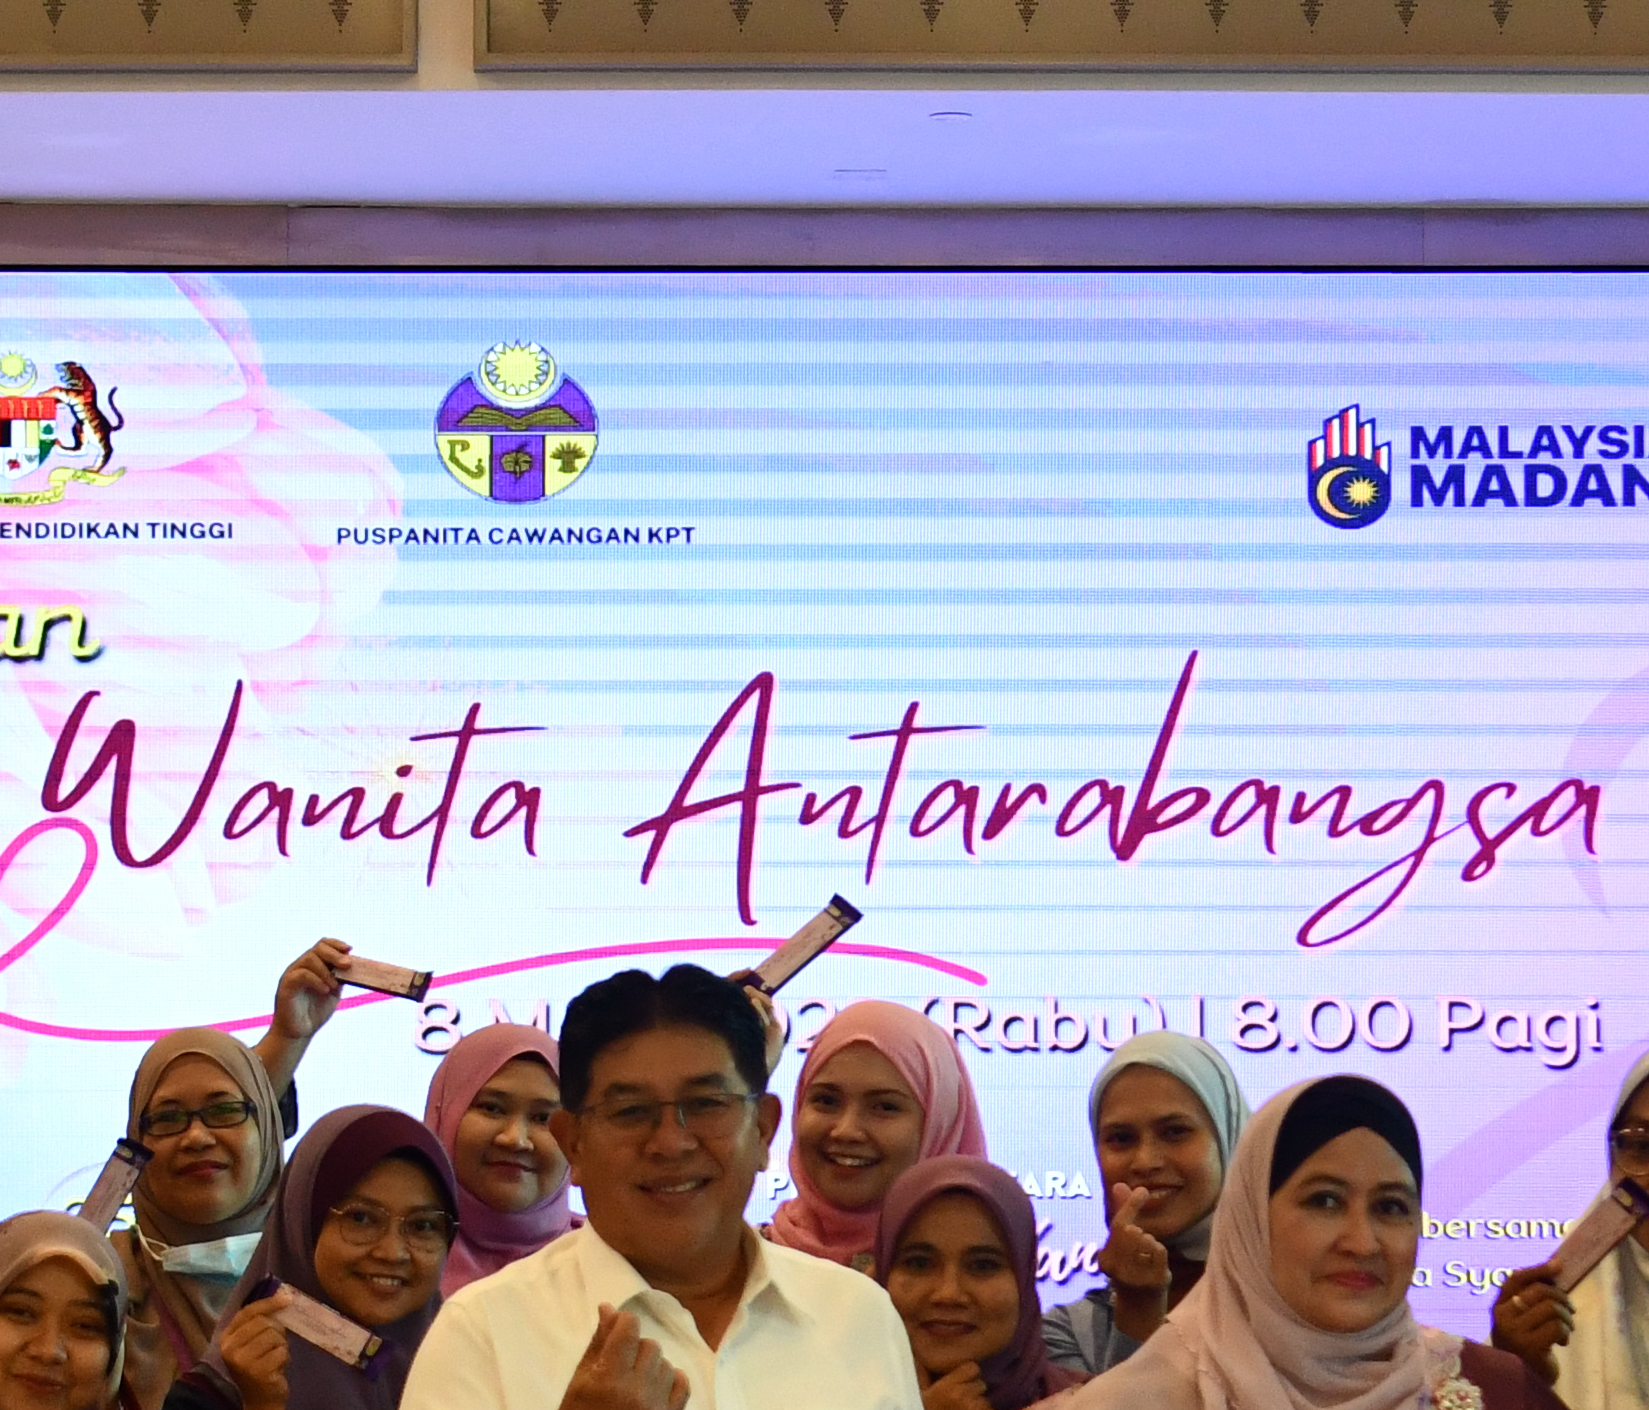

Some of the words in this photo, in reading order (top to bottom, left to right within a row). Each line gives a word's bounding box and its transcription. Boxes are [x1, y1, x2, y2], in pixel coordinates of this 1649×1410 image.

[144, 520, 235, 541] TINGGI
[335, 525, 482, 546] PUSPANITA
[487, 525, 642, 546] CAWANGAN
[647, 525, 697, 546] KPT
[41, 678, 548, 887] Wanita
[622, 650, 1601, 947] Antarabangsa
[1229, 994, 1414, 1053] 8.00
[1435, 994, 1604, 1070] Pagi
